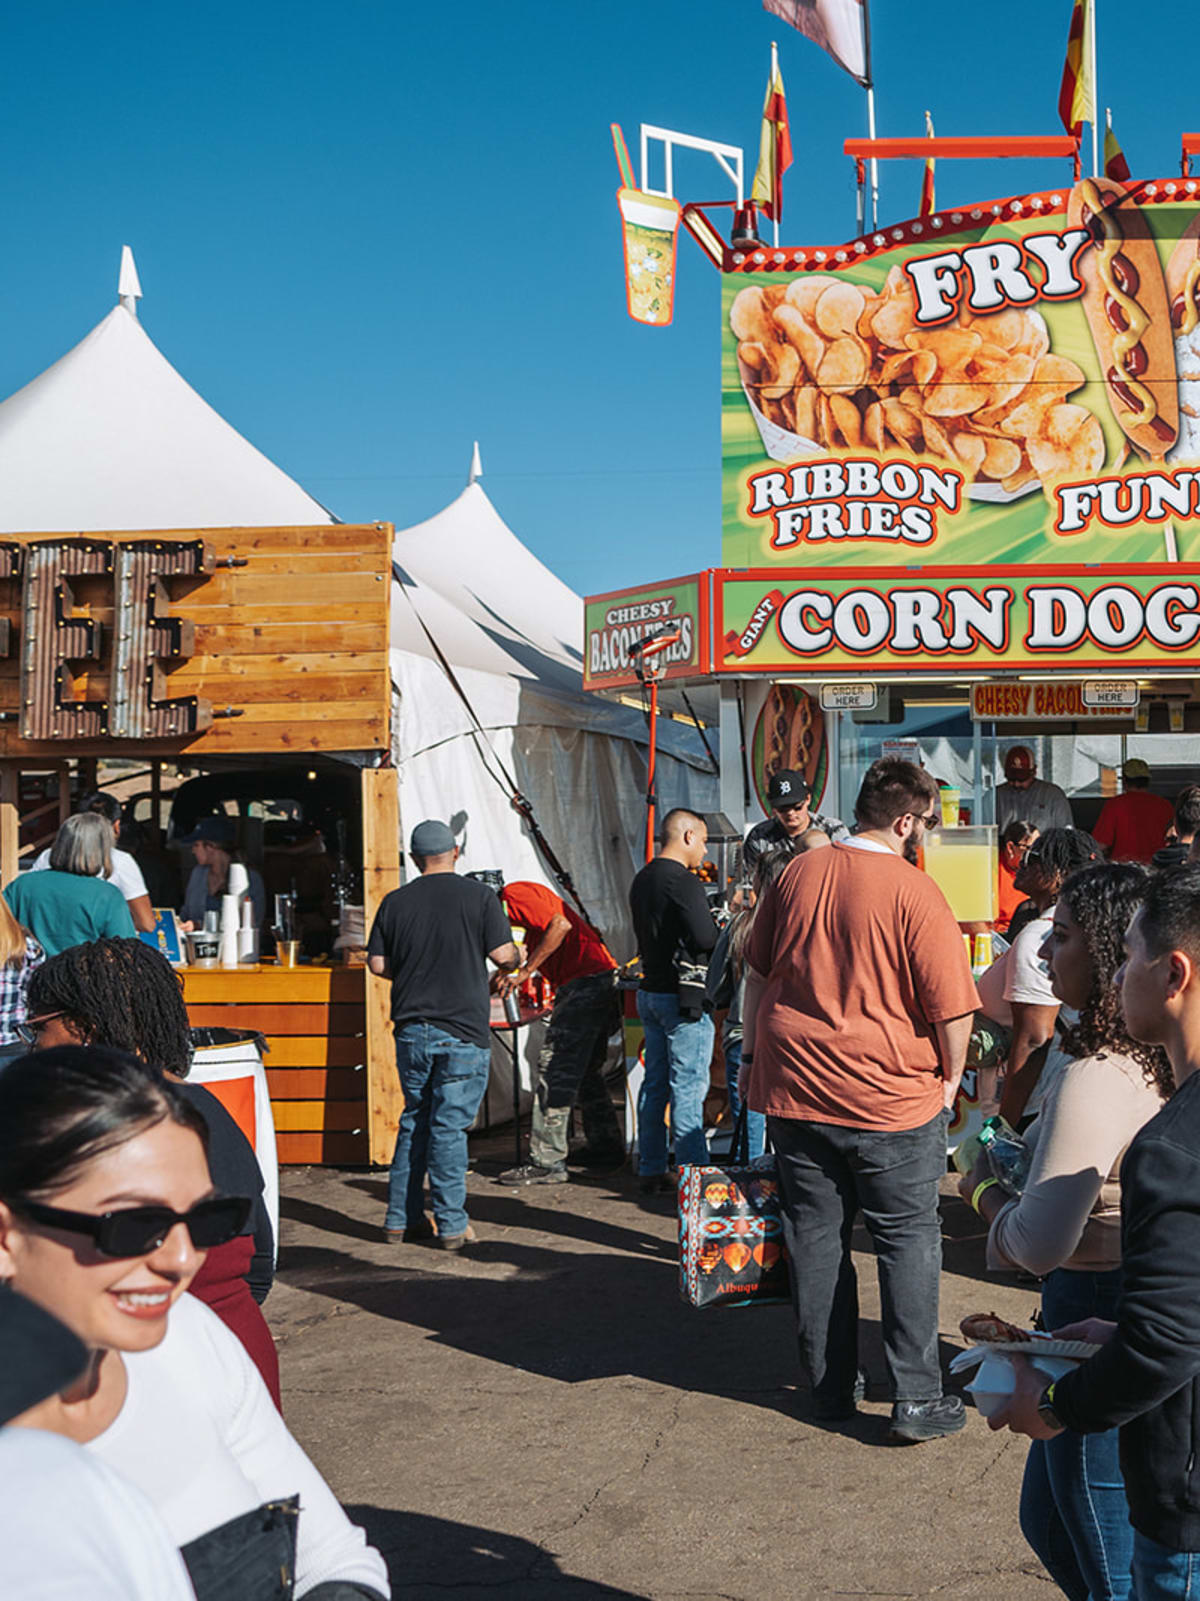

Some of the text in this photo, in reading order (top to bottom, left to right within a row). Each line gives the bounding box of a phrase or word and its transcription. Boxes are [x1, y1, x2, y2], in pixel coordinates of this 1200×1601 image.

[905, 228, 1092, 325] FRY
[750, 461, 962, 514] RIBBON
[771, 501, 936, 547] FRIES
[606, 599, 673, 625] CHEESY
[740, 598, 774, 649] GIANT
[779, 585, 1013, 654] CORN
[0, 539, 212, 739] EE
[831, 686, 865, 696] ORDER
[836, 696, 861, 705] HERE
[974, 684, 1031, 716] CHEESY
[1094, 683, 1128, 692] ORDER
[1097, 692, 1123, 702] HERE
